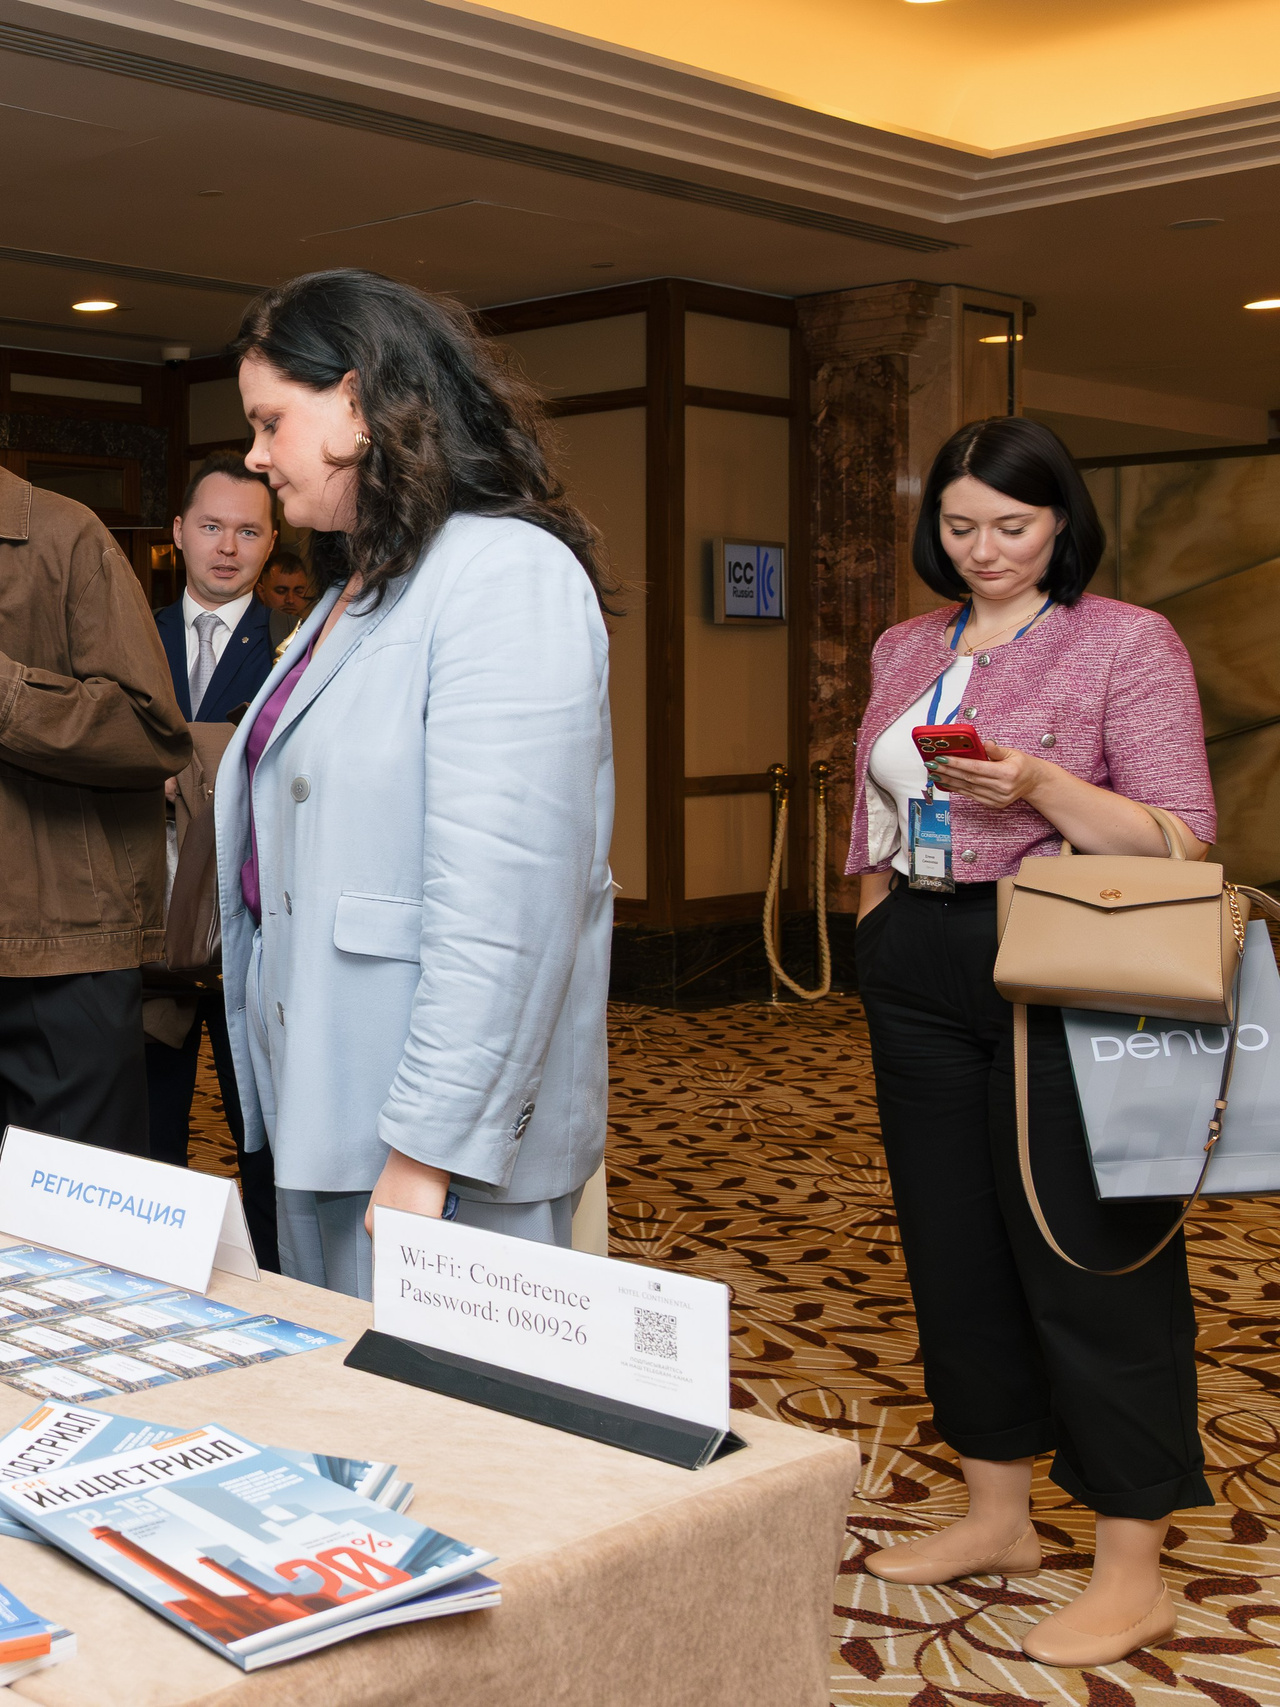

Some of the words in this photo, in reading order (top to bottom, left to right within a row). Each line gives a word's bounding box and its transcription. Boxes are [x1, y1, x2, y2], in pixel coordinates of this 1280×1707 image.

[728, 561, 754, 584] ICC
[732, 586, 754, 598] Russia
[30, 1169, 186, 1229] РЕГИСТРАЦИЯ
[399, 1244, 462, 1280] Wi-Fi:
[469, 1262, 591, 1311] Conference
[399, 1278, 500, 1323] Password:
[507, 1306, 588, 1346] 080926
[11, 1478, 52, 1492] CRE
[23, 1439, 244, 1508] ИНДАСТРИАЛ
